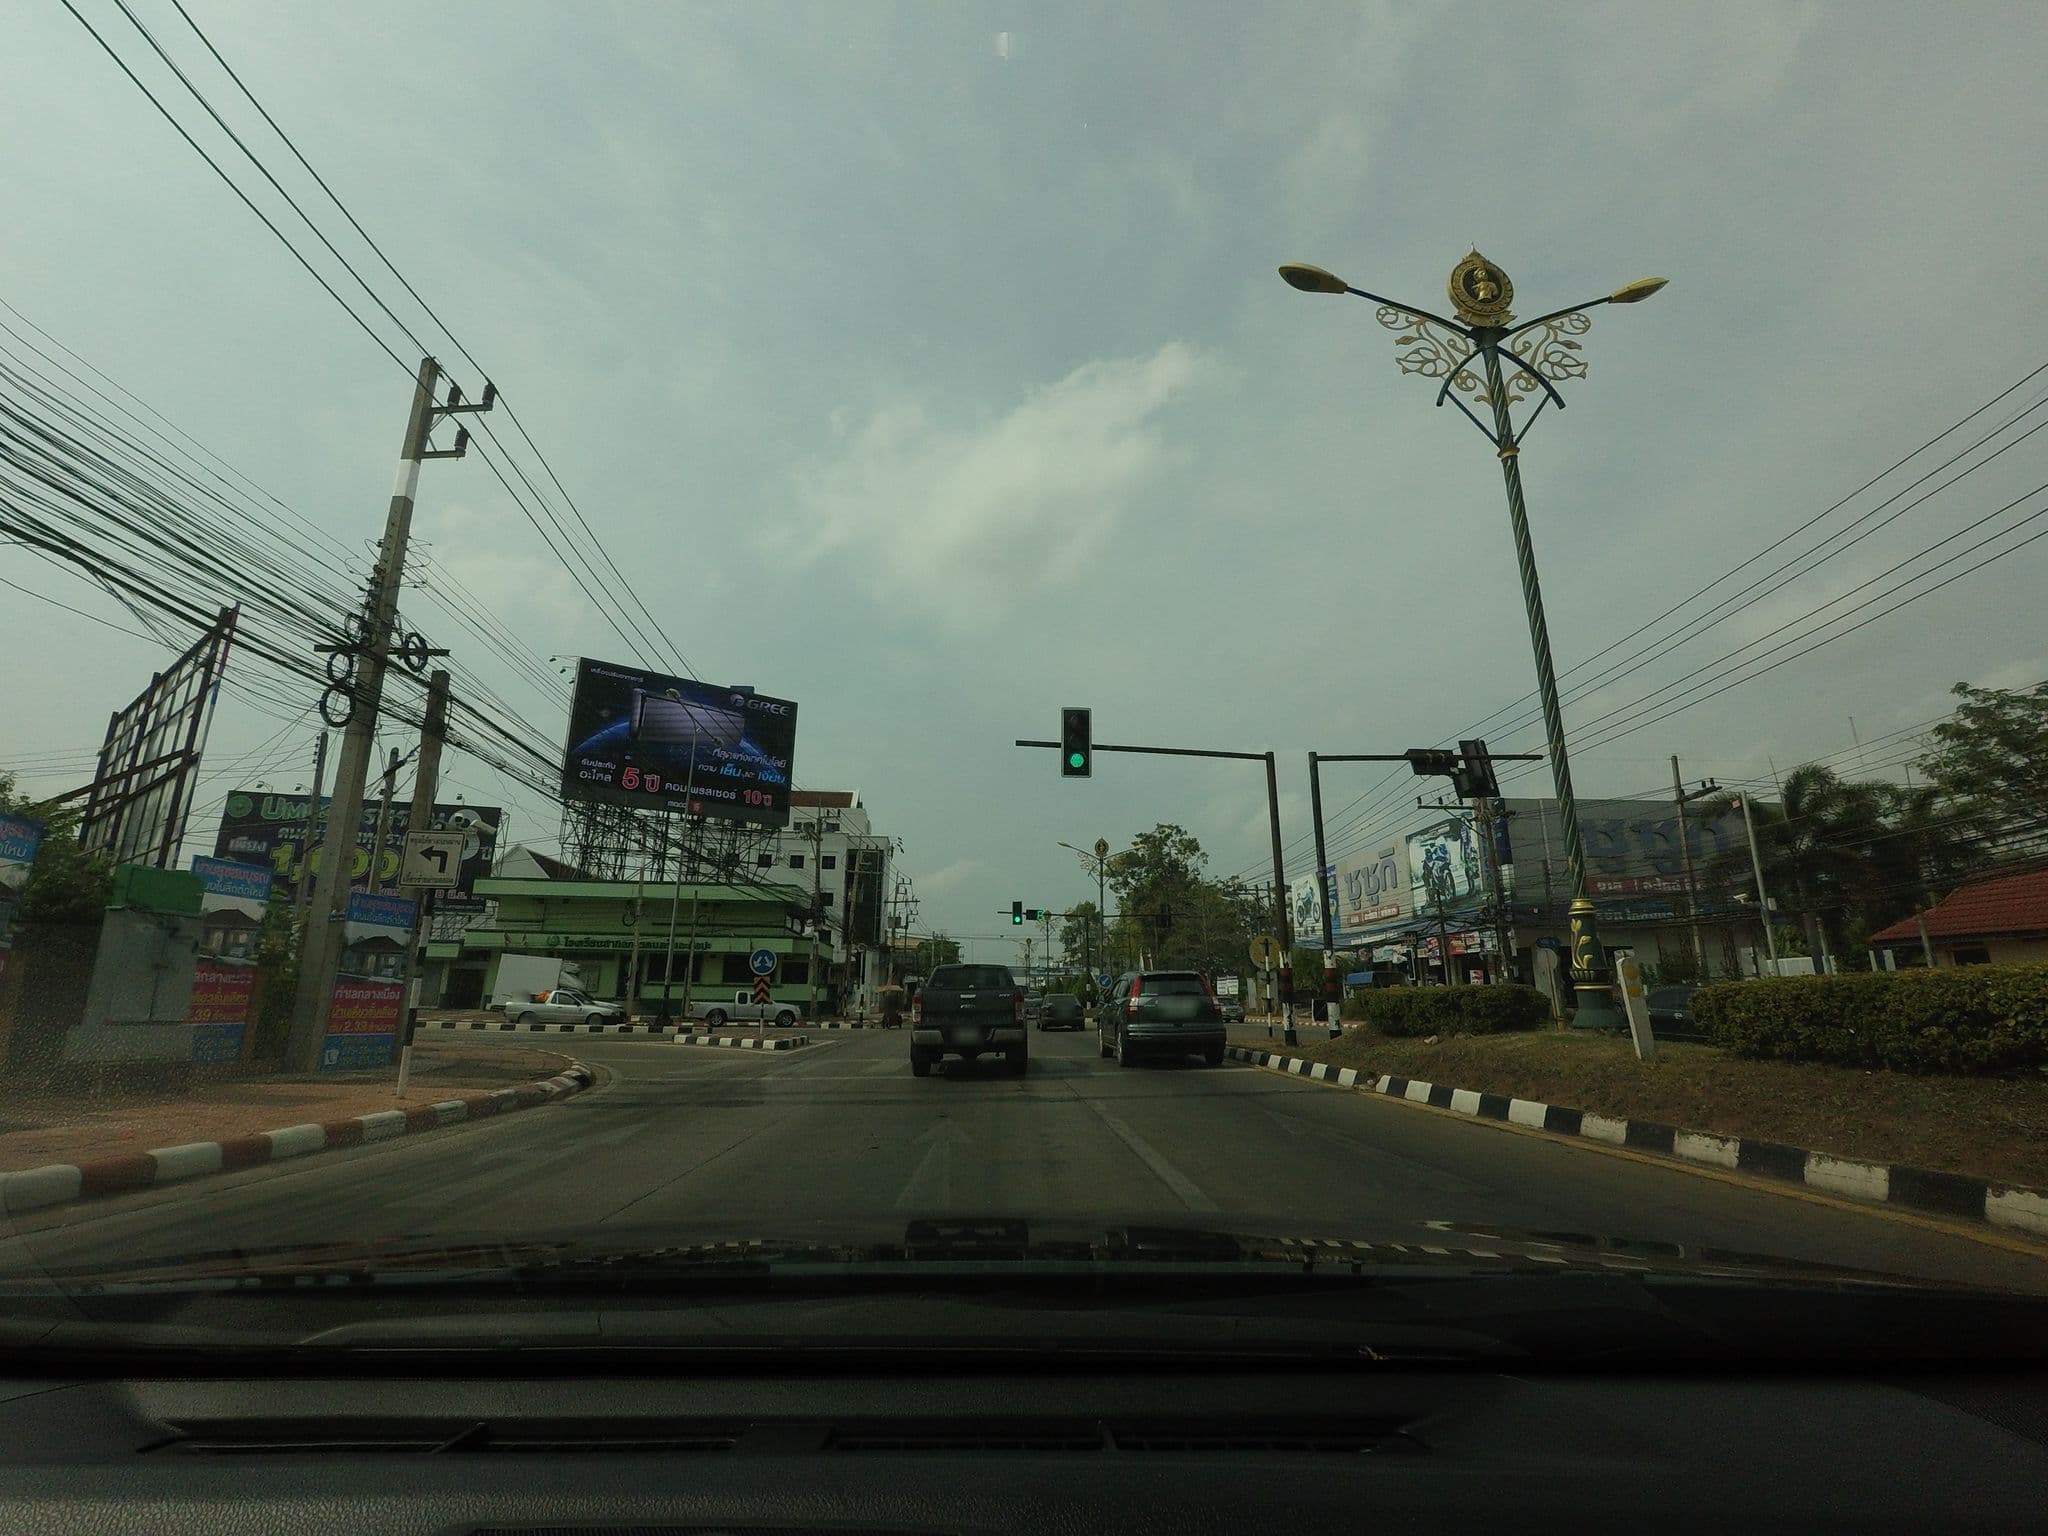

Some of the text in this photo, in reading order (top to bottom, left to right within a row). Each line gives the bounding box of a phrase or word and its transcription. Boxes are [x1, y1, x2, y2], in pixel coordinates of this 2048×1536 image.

[746, 699, 791, 717] GREE
[621, 767, 640, 790] 5
[643, 773, 661, 793] ปี
[719, 763, 742, 777] เย็น
[1343, 846, 1398, 911] ซูซูกิ
